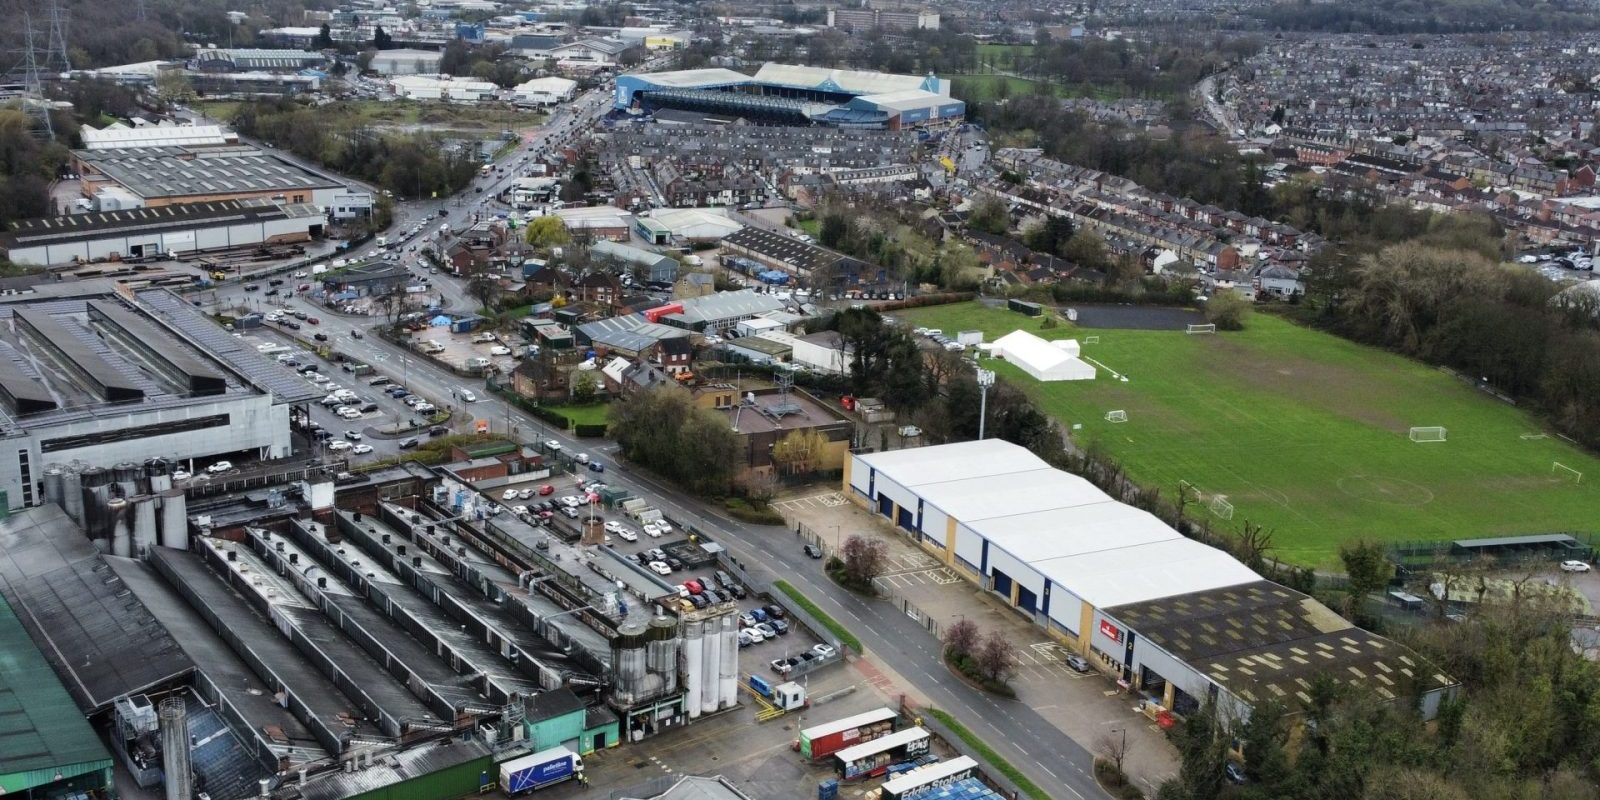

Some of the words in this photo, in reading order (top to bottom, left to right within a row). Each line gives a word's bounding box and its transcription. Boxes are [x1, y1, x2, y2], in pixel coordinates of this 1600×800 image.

[1045, 587, 1049, 595] 3
[1128, 642, 1133, 650] 2
[901, 785, 931, 800] Eddie
[932, 769, 971, 790] Stobart
